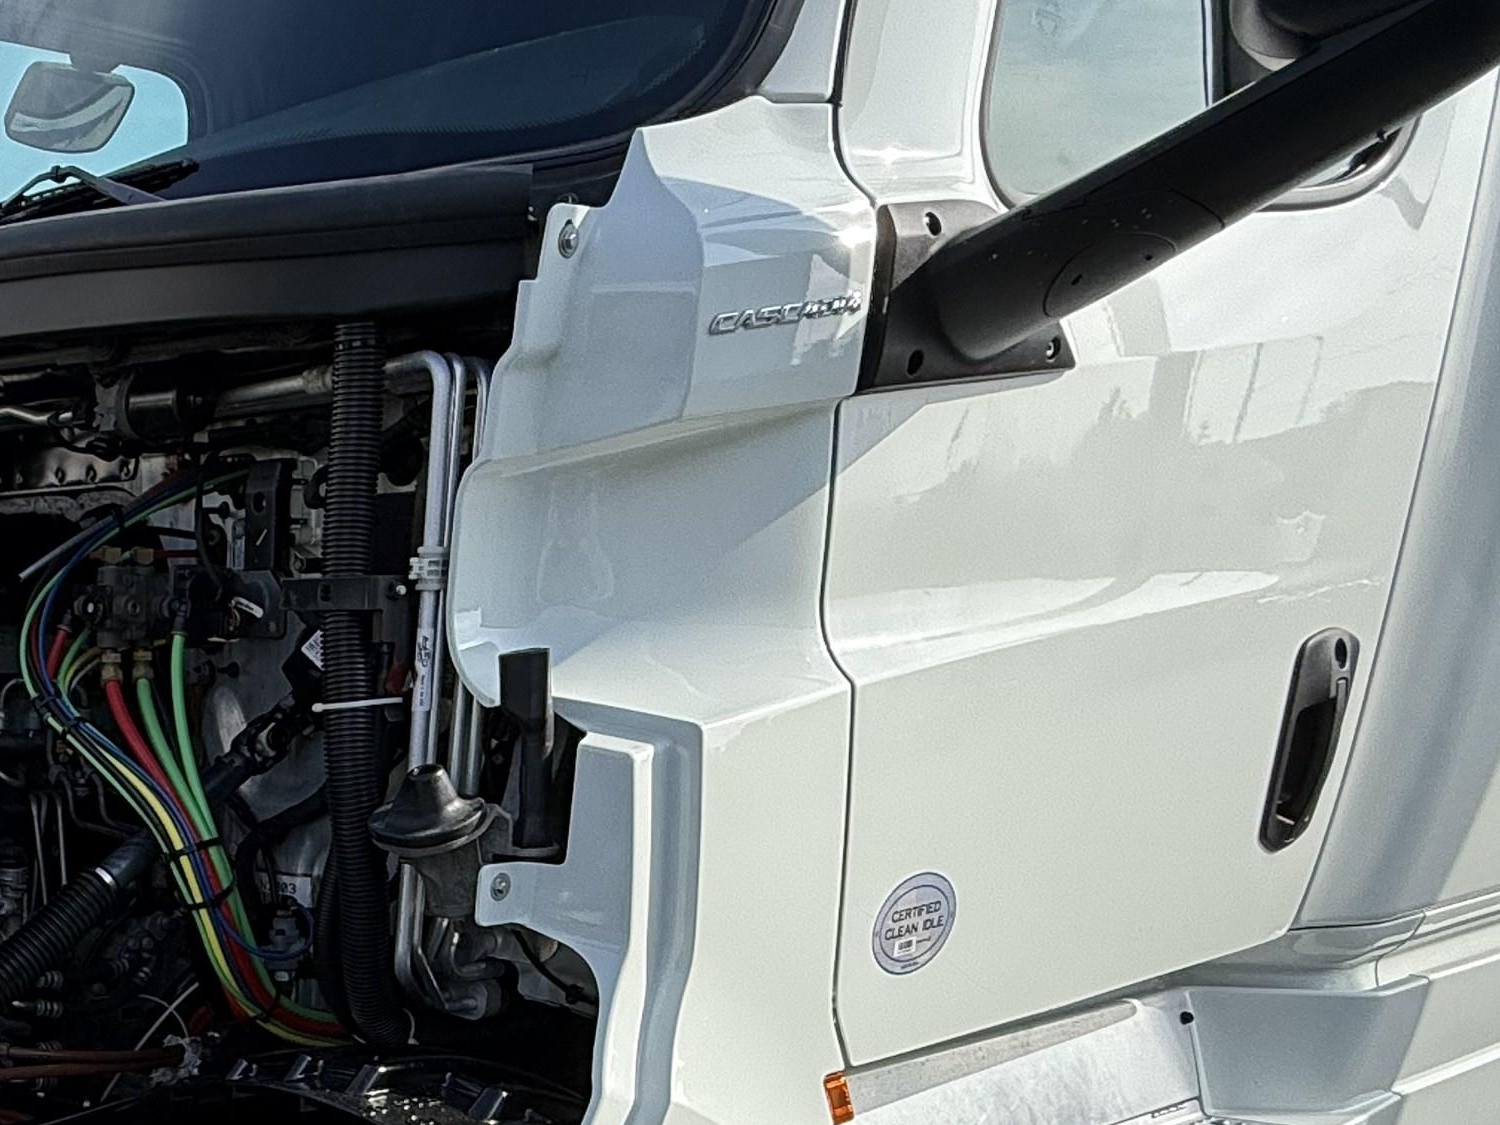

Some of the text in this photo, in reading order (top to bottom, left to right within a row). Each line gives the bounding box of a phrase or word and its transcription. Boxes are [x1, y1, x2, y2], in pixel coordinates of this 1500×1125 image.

[708, 290, 861, 335] CASC
[891, 900, 941, 923] CERTIFIED
[884, 915, 944, 941] CLEAN IDLE
